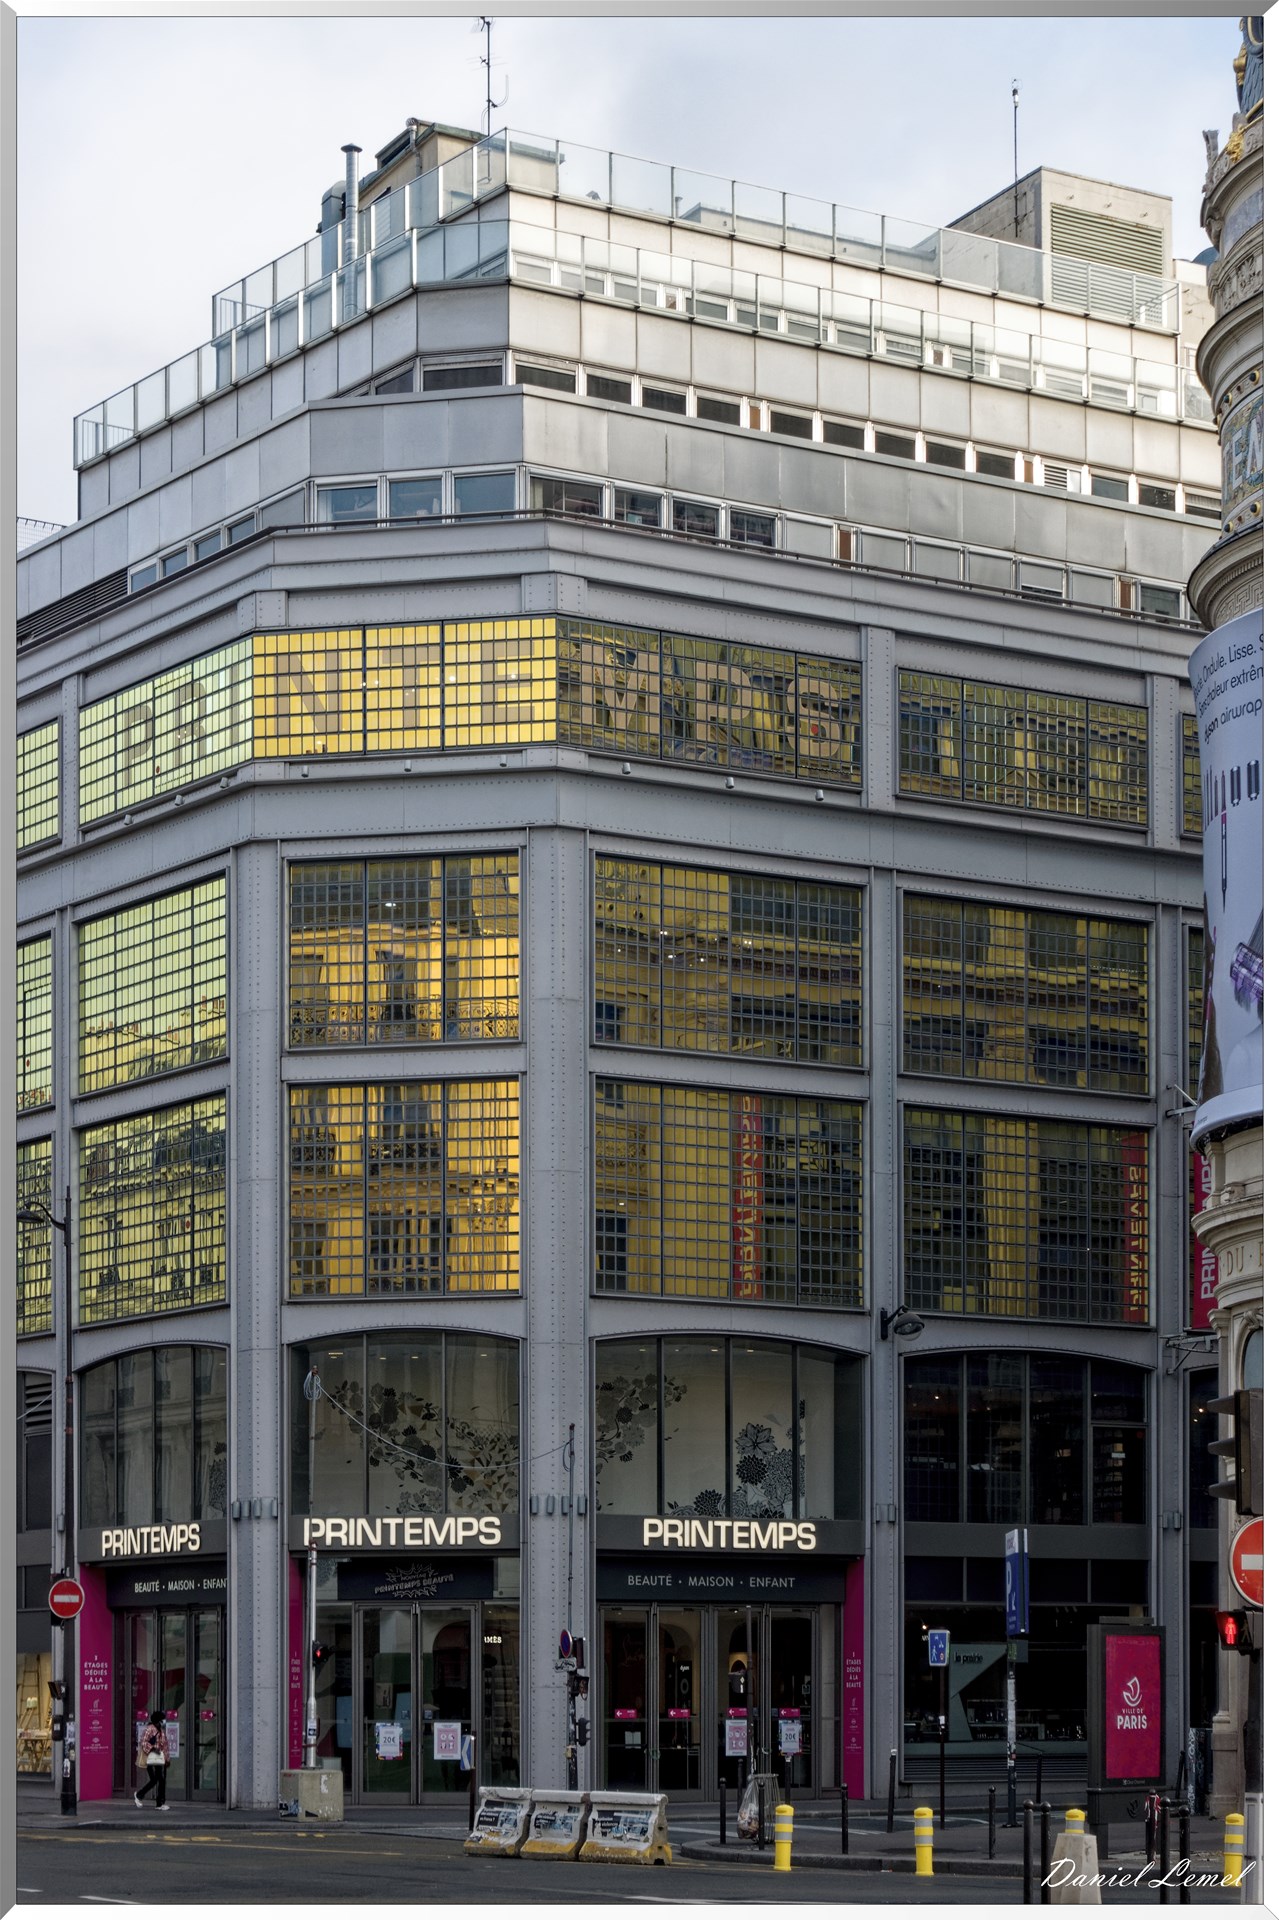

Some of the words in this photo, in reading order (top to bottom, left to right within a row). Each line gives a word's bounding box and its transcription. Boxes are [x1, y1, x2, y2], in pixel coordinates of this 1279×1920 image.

[1228, 643, 1257, 663] Lisse.
[1220, 698, 1263, 725] airwrap
[1226, 1246, 1245, 1276] DU
[102, 1523, 200, 1557] PRINTEMPS
[303, 1516, 502, 1547] PRINTEMPS
[643, 1518, 817, 1550] PRINTEMPS
[134, 1581, 160, 1593] BEAUTÉ
[168, 1580, 195, 1591] MAISON
[627, 1573, 673, 1586] BEAUTÉ
[688, 1576, 734, 1587] MAISON
[749, 1577, 795, 1588] ENFANT
[1117, 1715, 1147, 1729] PARIS
